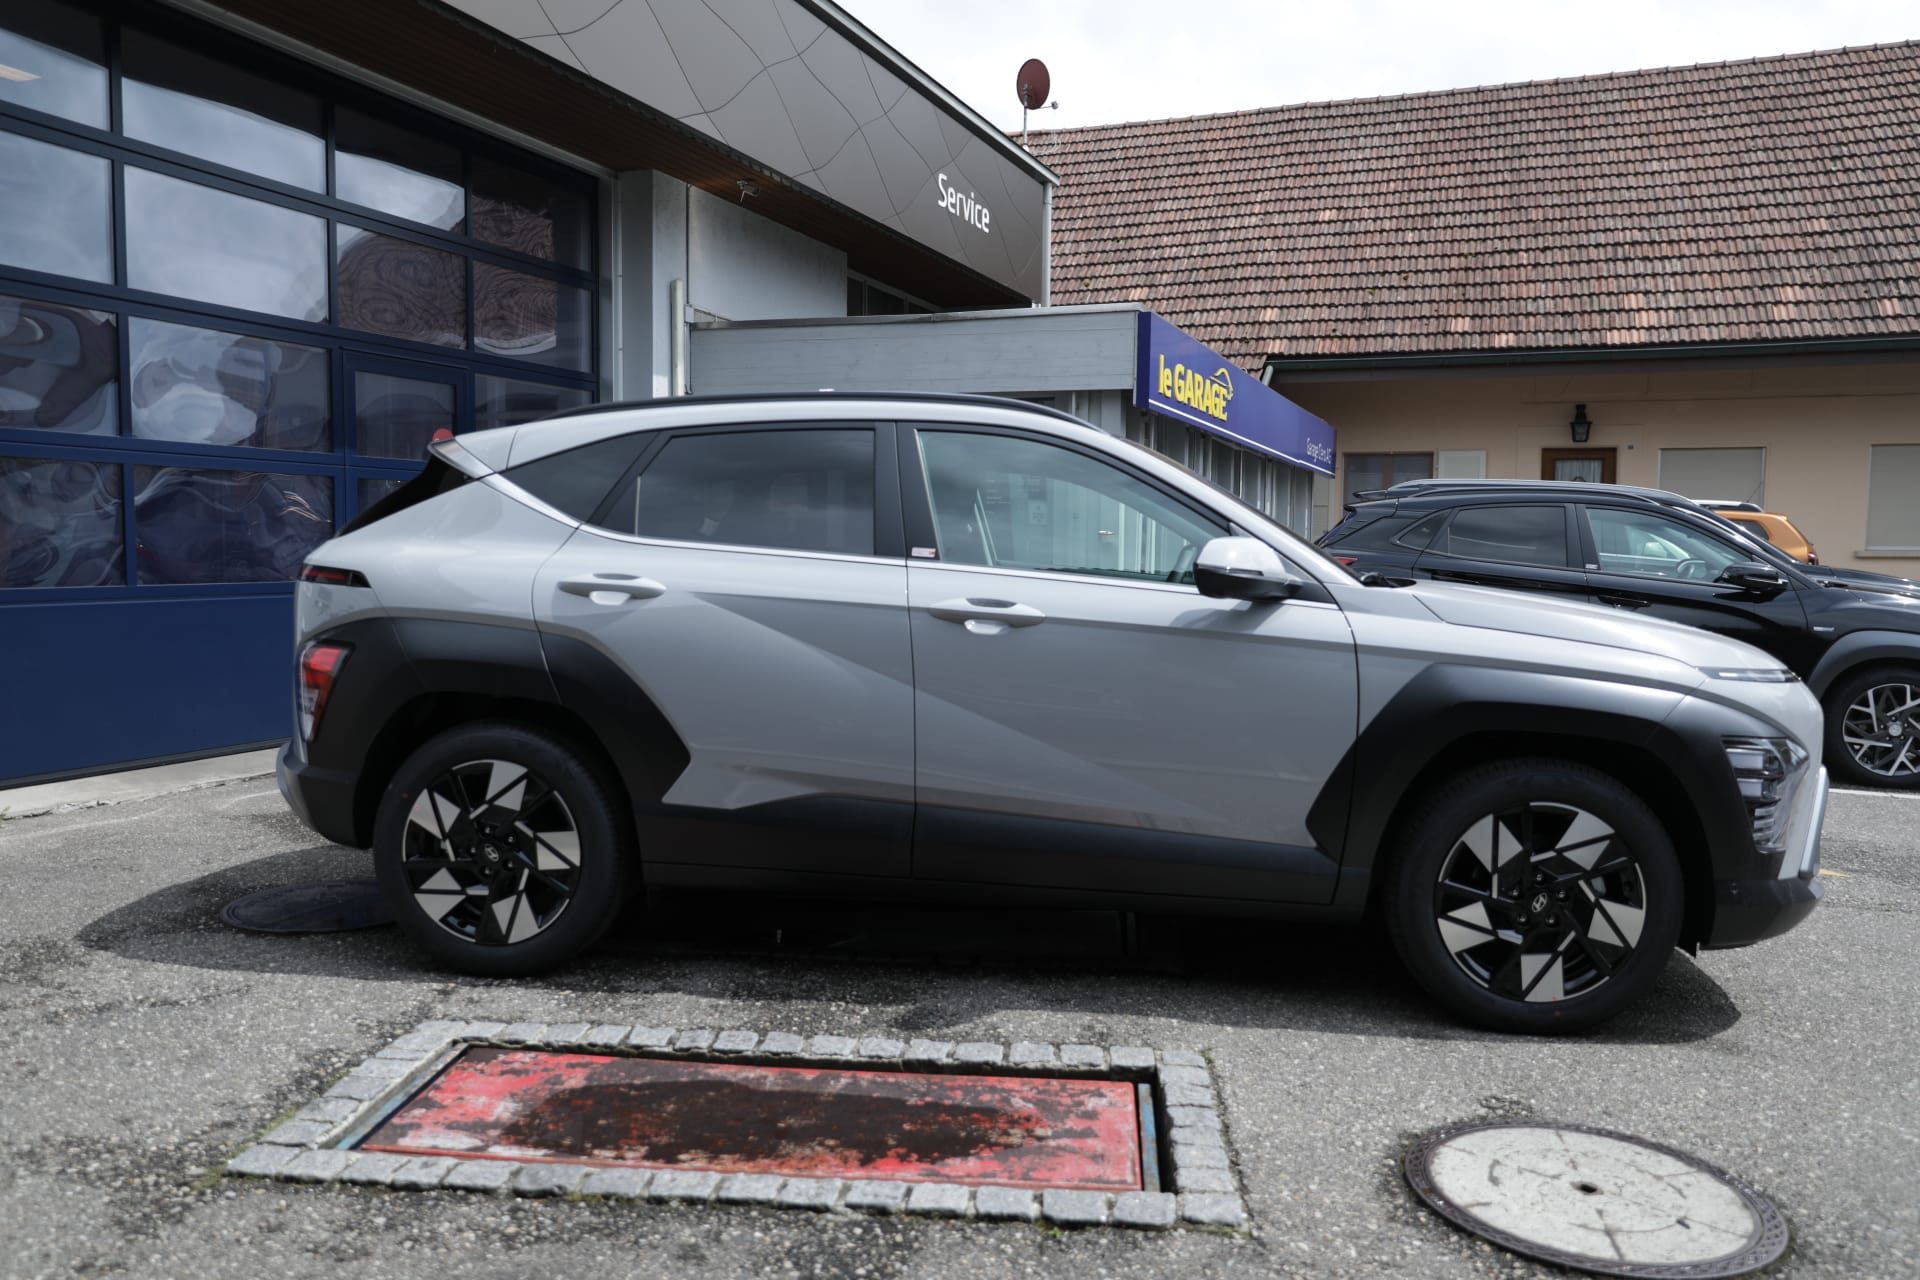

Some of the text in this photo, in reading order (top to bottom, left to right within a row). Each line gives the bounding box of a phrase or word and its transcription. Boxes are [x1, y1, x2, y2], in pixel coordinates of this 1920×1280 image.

[938, 173, 990, 233] Service
[1158, 354, 1228, 421] le GARAGE
[1306, 437, 1318, 463] Garage
